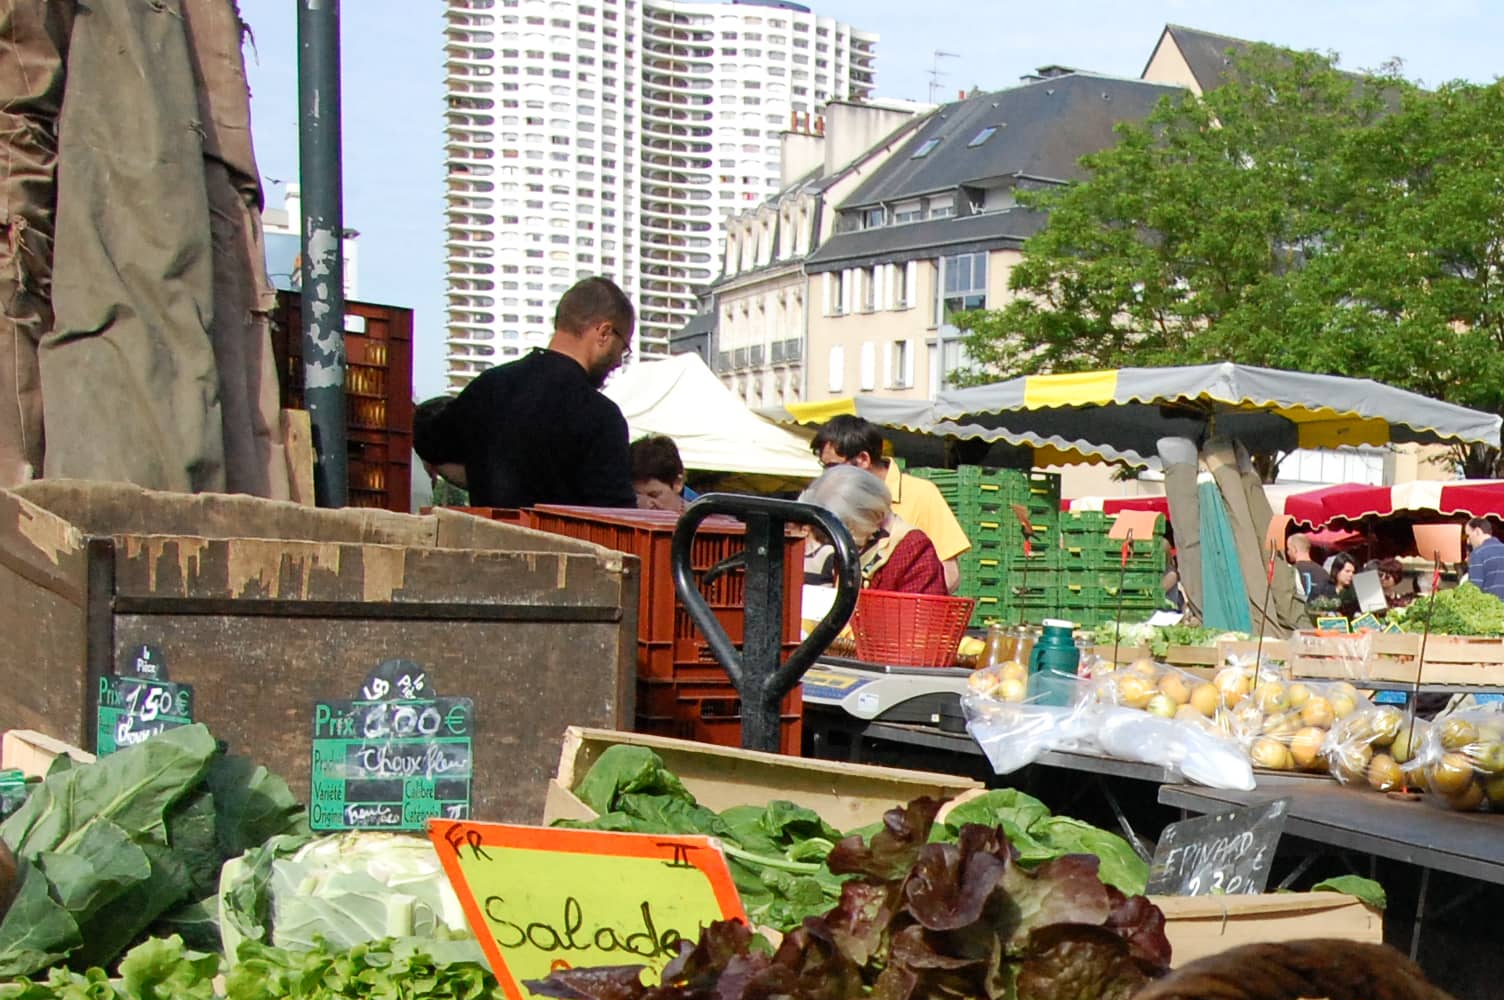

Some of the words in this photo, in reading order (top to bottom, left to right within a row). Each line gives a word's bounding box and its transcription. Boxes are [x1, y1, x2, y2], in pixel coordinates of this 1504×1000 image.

[99, 677, 121, 705] Prix
[316, 704, 355, 736] Prix
[444, 705, 468, 735] €
[445, 823, 493, 860] FR
[485, 896, 684, 960] Salade
